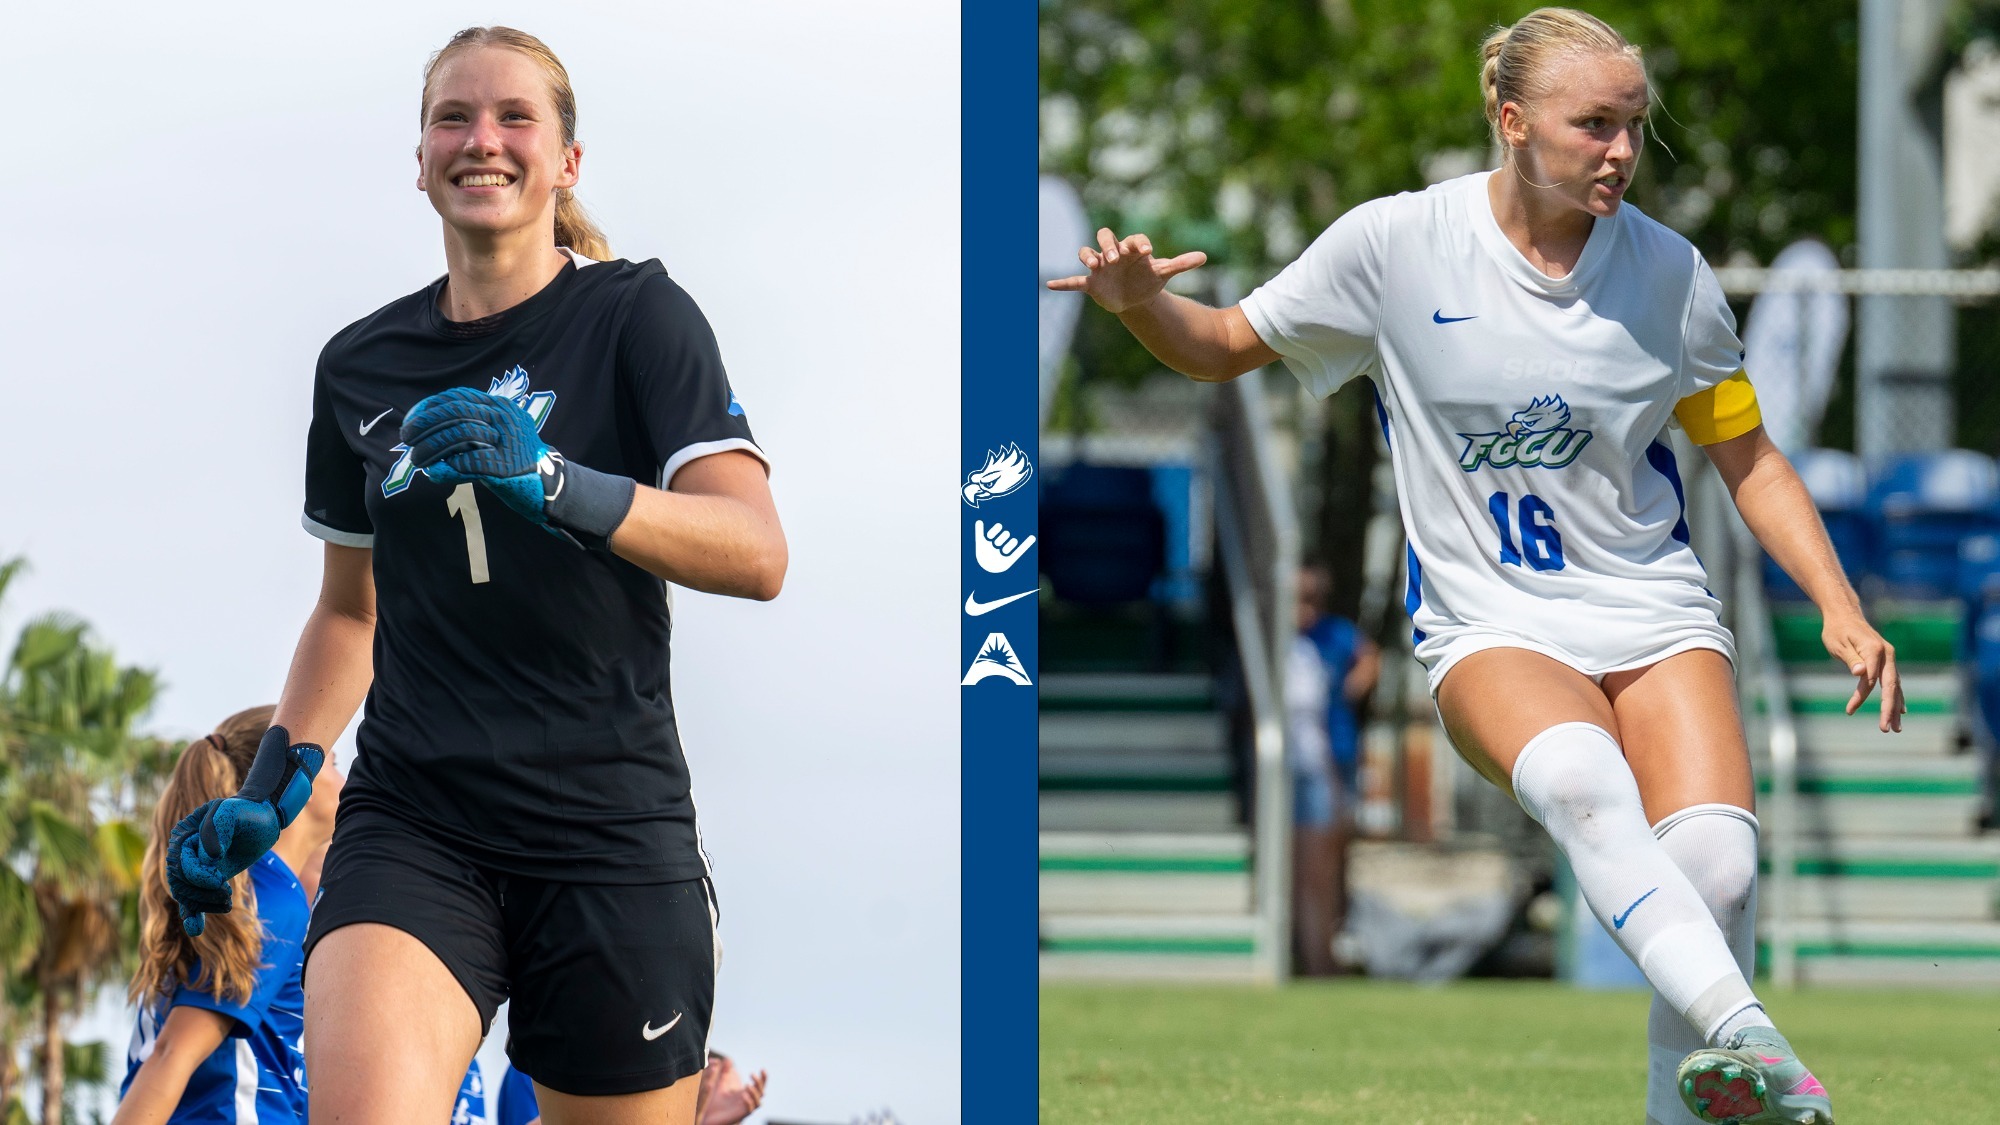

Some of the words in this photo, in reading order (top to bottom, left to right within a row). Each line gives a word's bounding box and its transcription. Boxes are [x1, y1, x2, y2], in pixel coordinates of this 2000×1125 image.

[1456, 428, 1593, 472] FGCU
[446, 482, 490, 584] 1
[1489, 491, 1566, 572] 16
